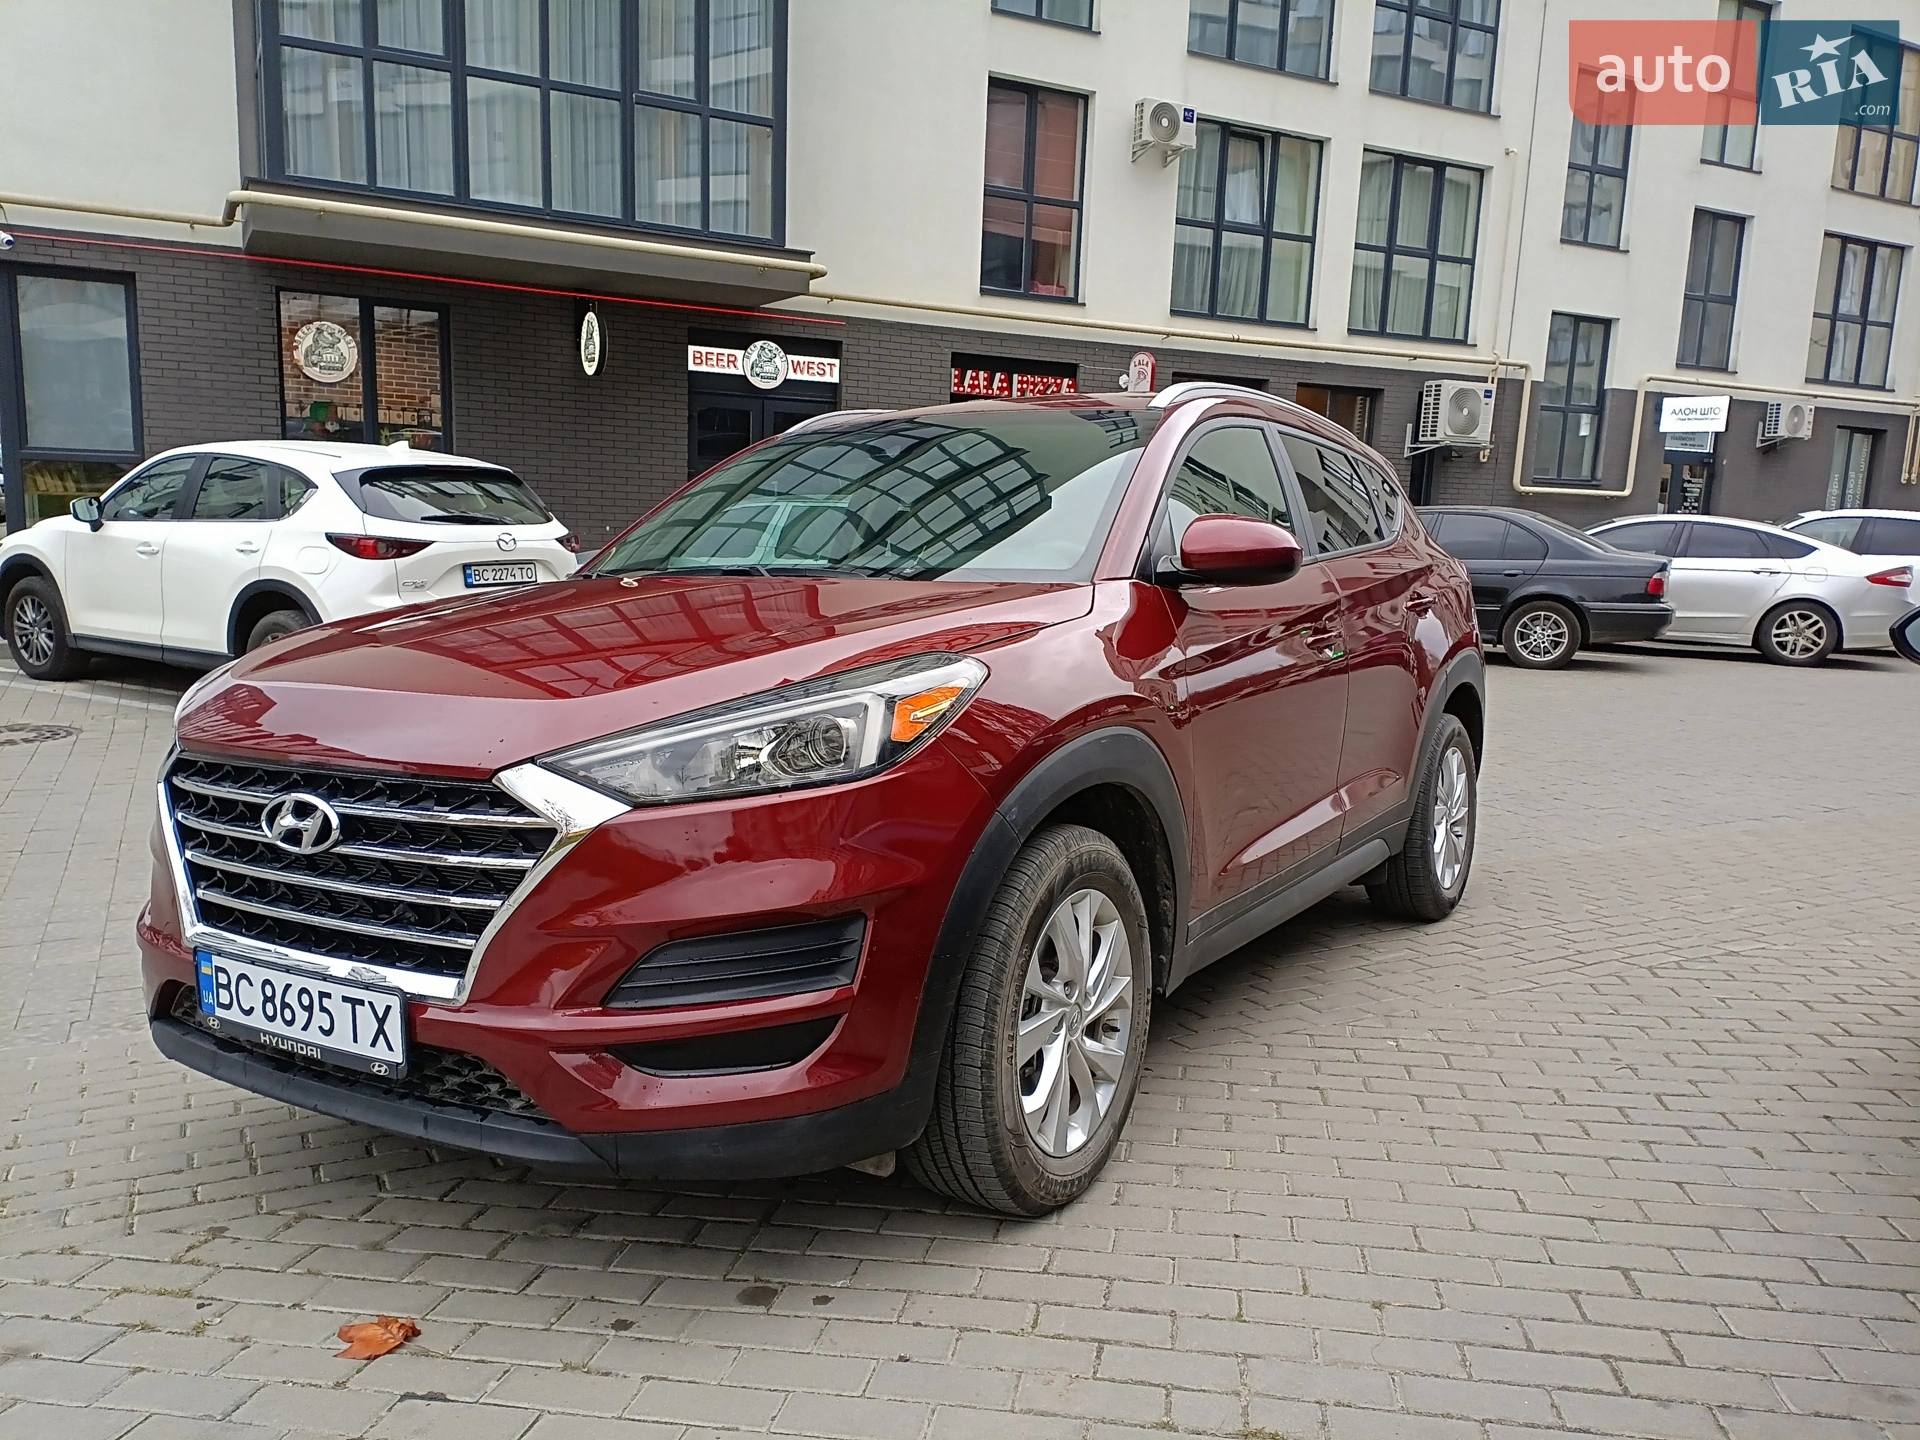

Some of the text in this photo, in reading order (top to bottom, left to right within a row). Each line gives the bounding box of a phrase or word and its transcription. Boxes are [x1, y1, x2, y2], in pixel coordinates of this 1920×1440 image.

[692, 350, 837, 378] BEER WEST
[1133, 359, 1149, 368] LALA
[951, 368, 1078, 399] LALA PIZZA
[473, 566, 534, 582] BC 2274 TO
[203, 989, 214, 1006] UA
[213, 964, 395, 1053] BC 8695 TX
[1006, 943, 1031, 1067] ALL-SEASON
[259, 1031, 321, 1060] HYUNDAI
